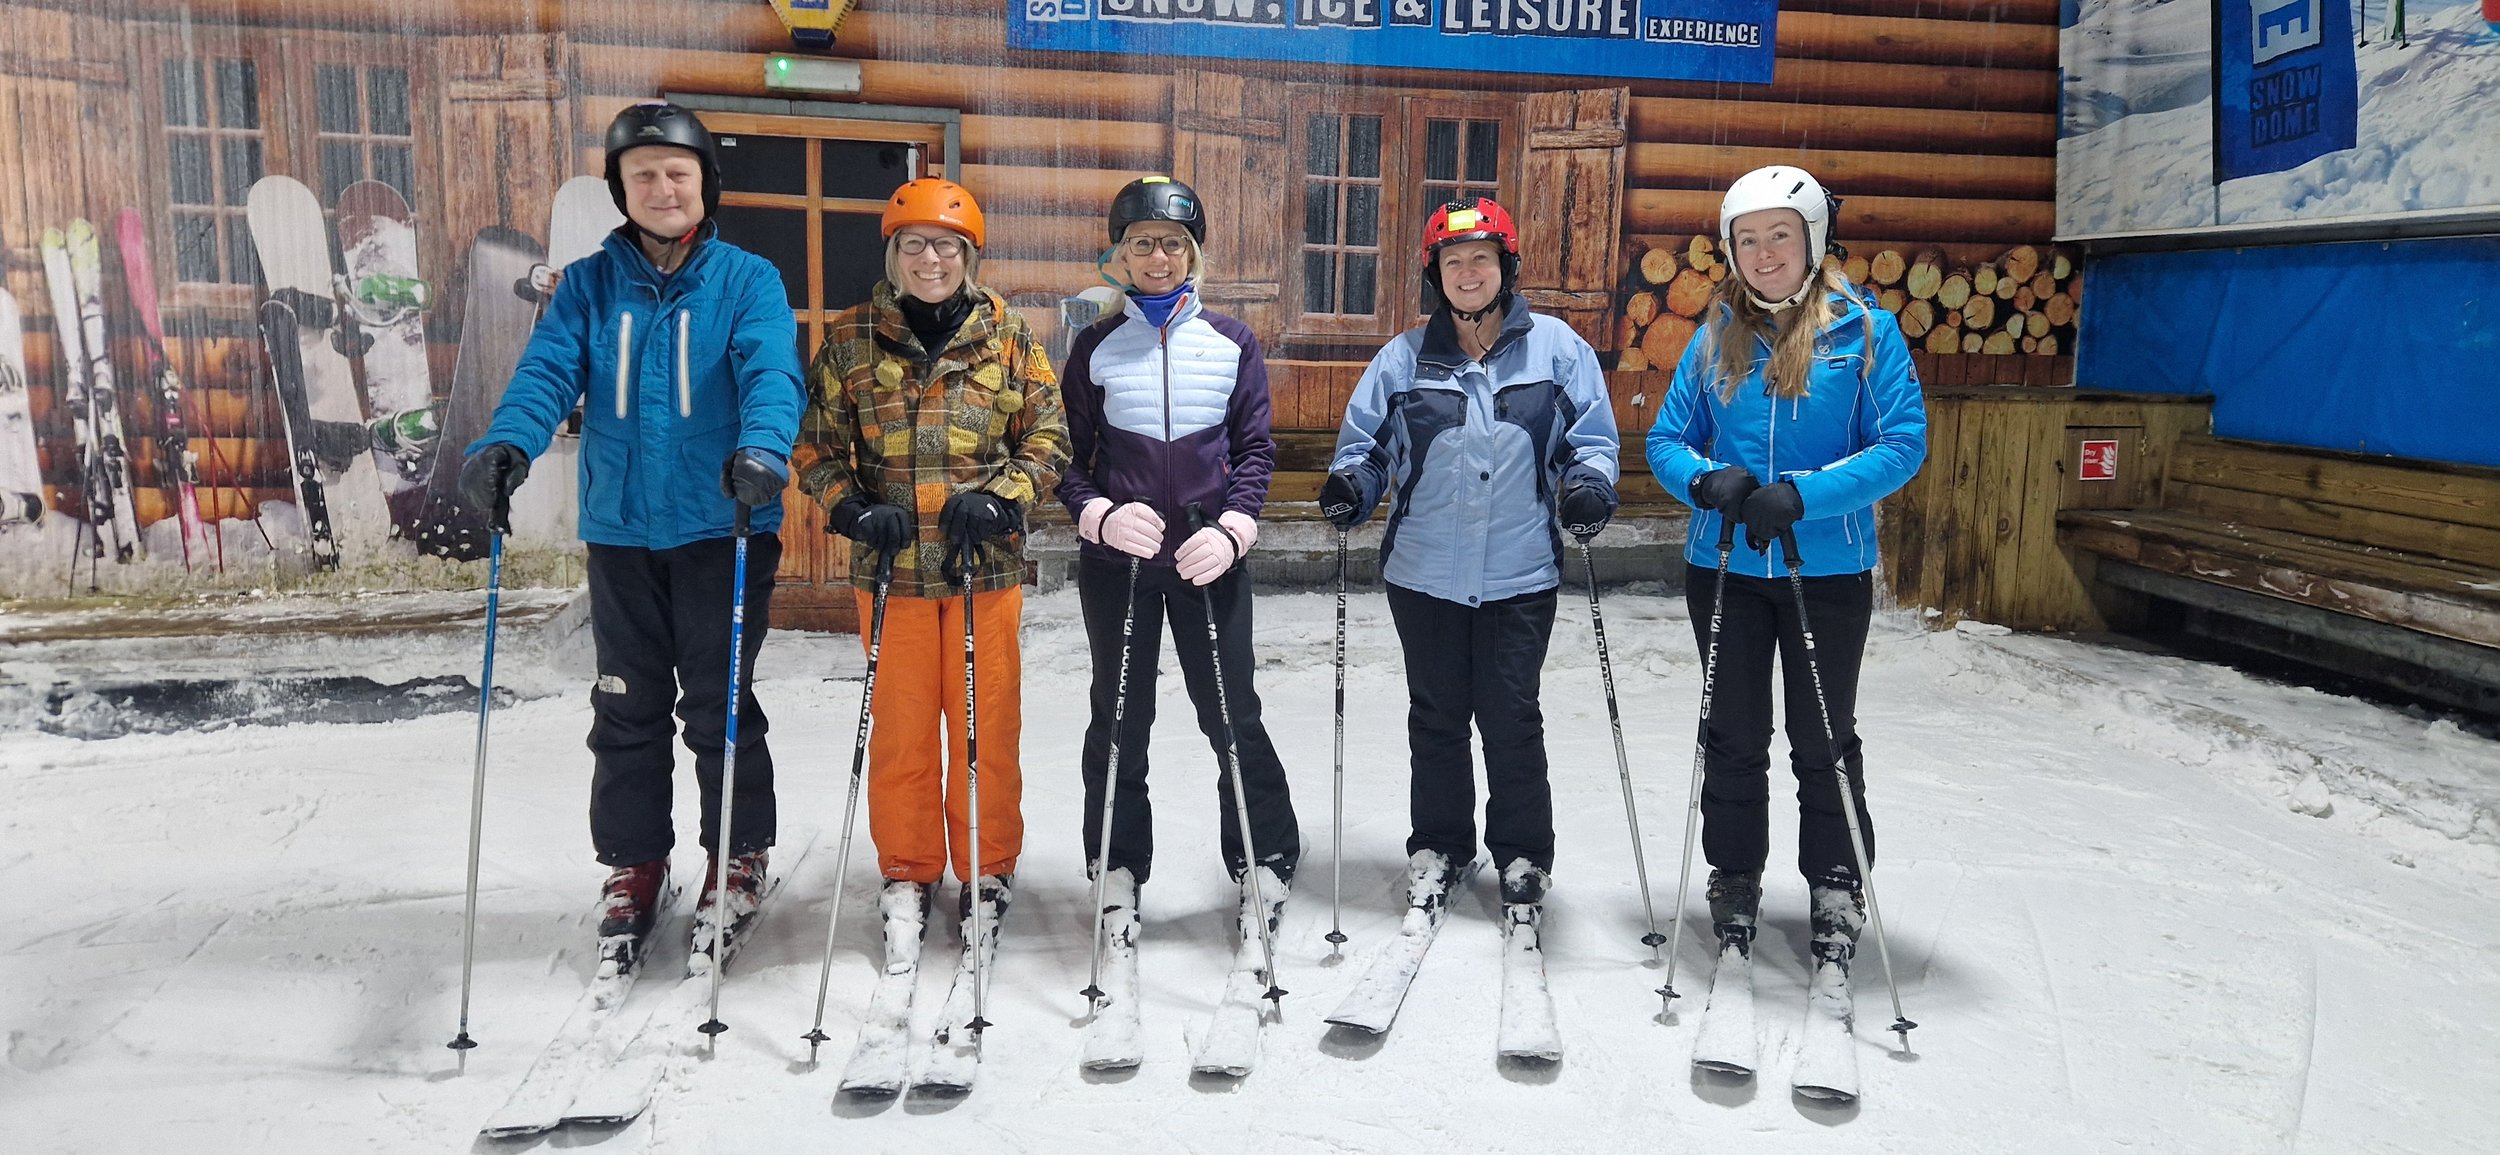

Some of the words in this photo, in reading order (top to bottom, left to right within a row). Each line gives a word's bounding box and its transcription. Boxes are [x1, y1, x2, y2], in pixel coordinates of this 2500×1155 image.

[1445, 0, 1631, 35] LEISURE
[1649, 21, 1760, 44] EXPERIENCE
[2253, 66, 2320, 111] SNOW
[2254, 101, 2317, 145] DOME
[965, 662, 975, 740] SALOMON
